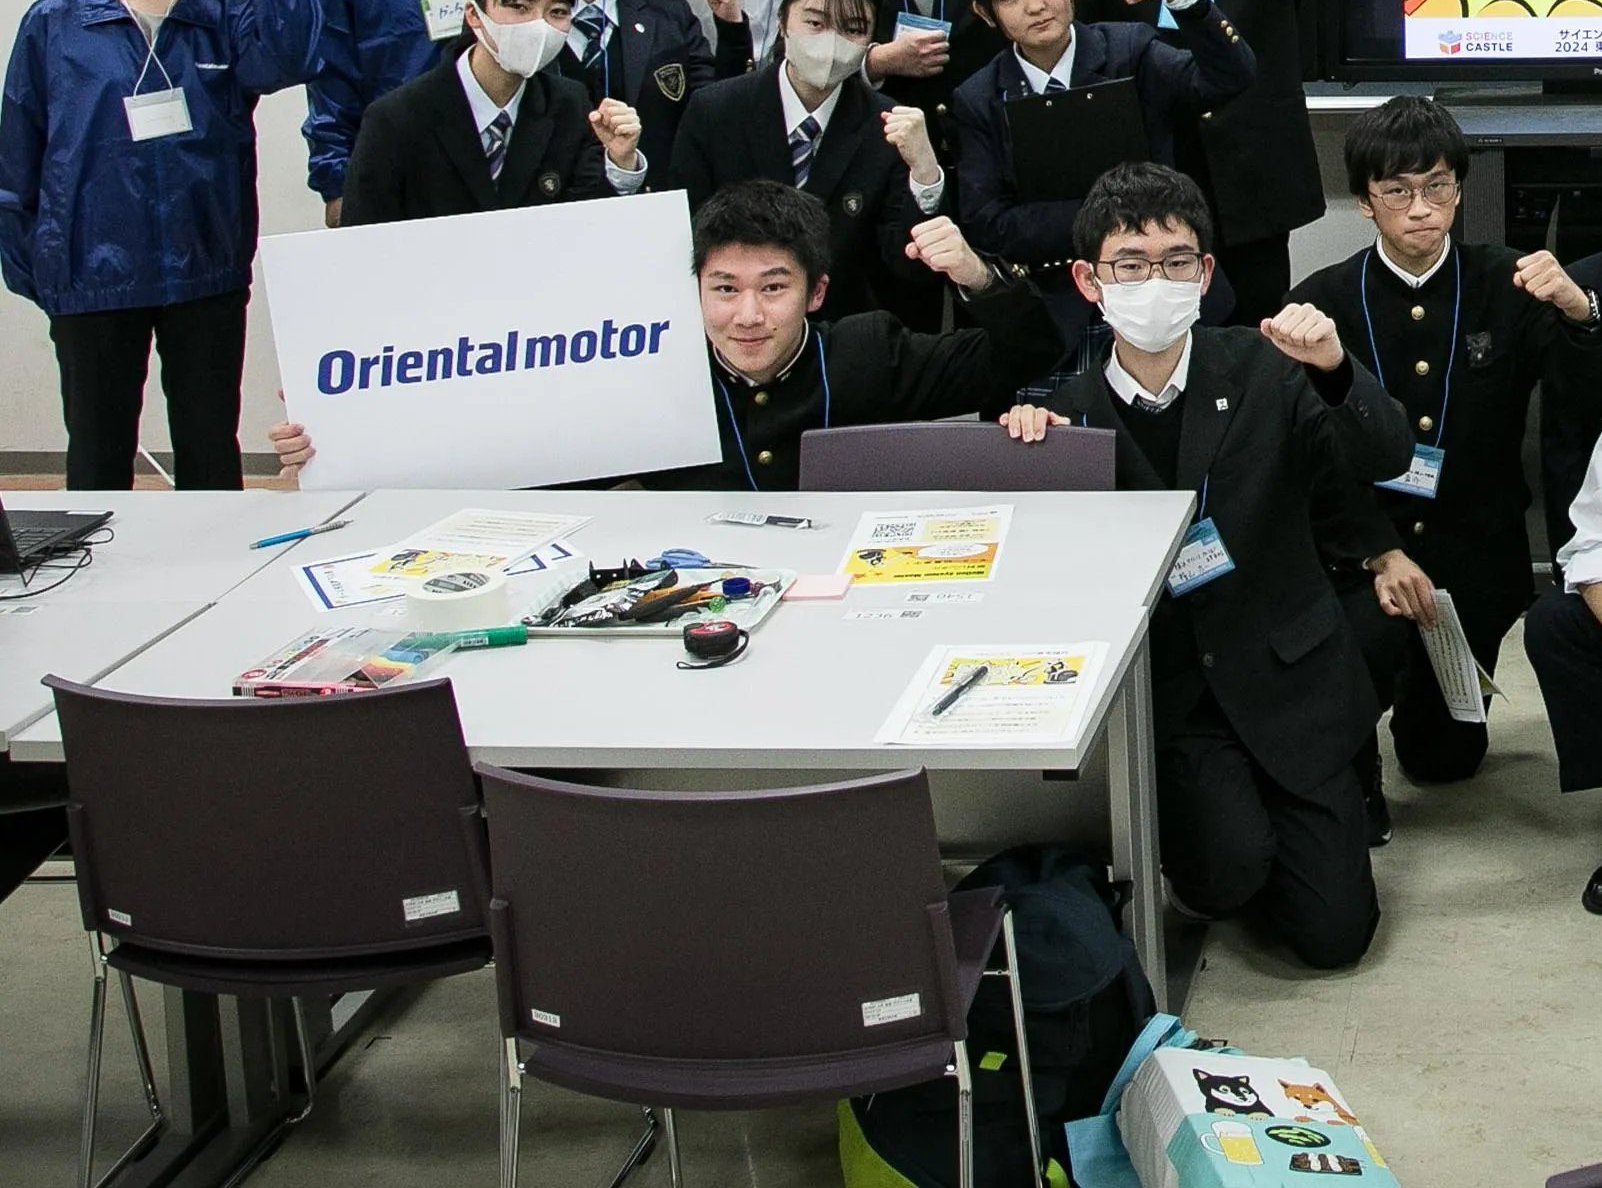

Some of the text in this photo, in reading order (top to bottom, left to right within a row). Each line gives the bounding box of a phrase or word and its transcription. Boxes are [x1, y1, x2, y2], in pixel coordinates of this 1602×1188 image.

[1465, 31, 1513, 41] SCIENCE
[1466, 42, 1513, 52] CASTLE
[1555, 41, 1589, 53] 2024
[317, 319, 671, 396] Orientalmotor
